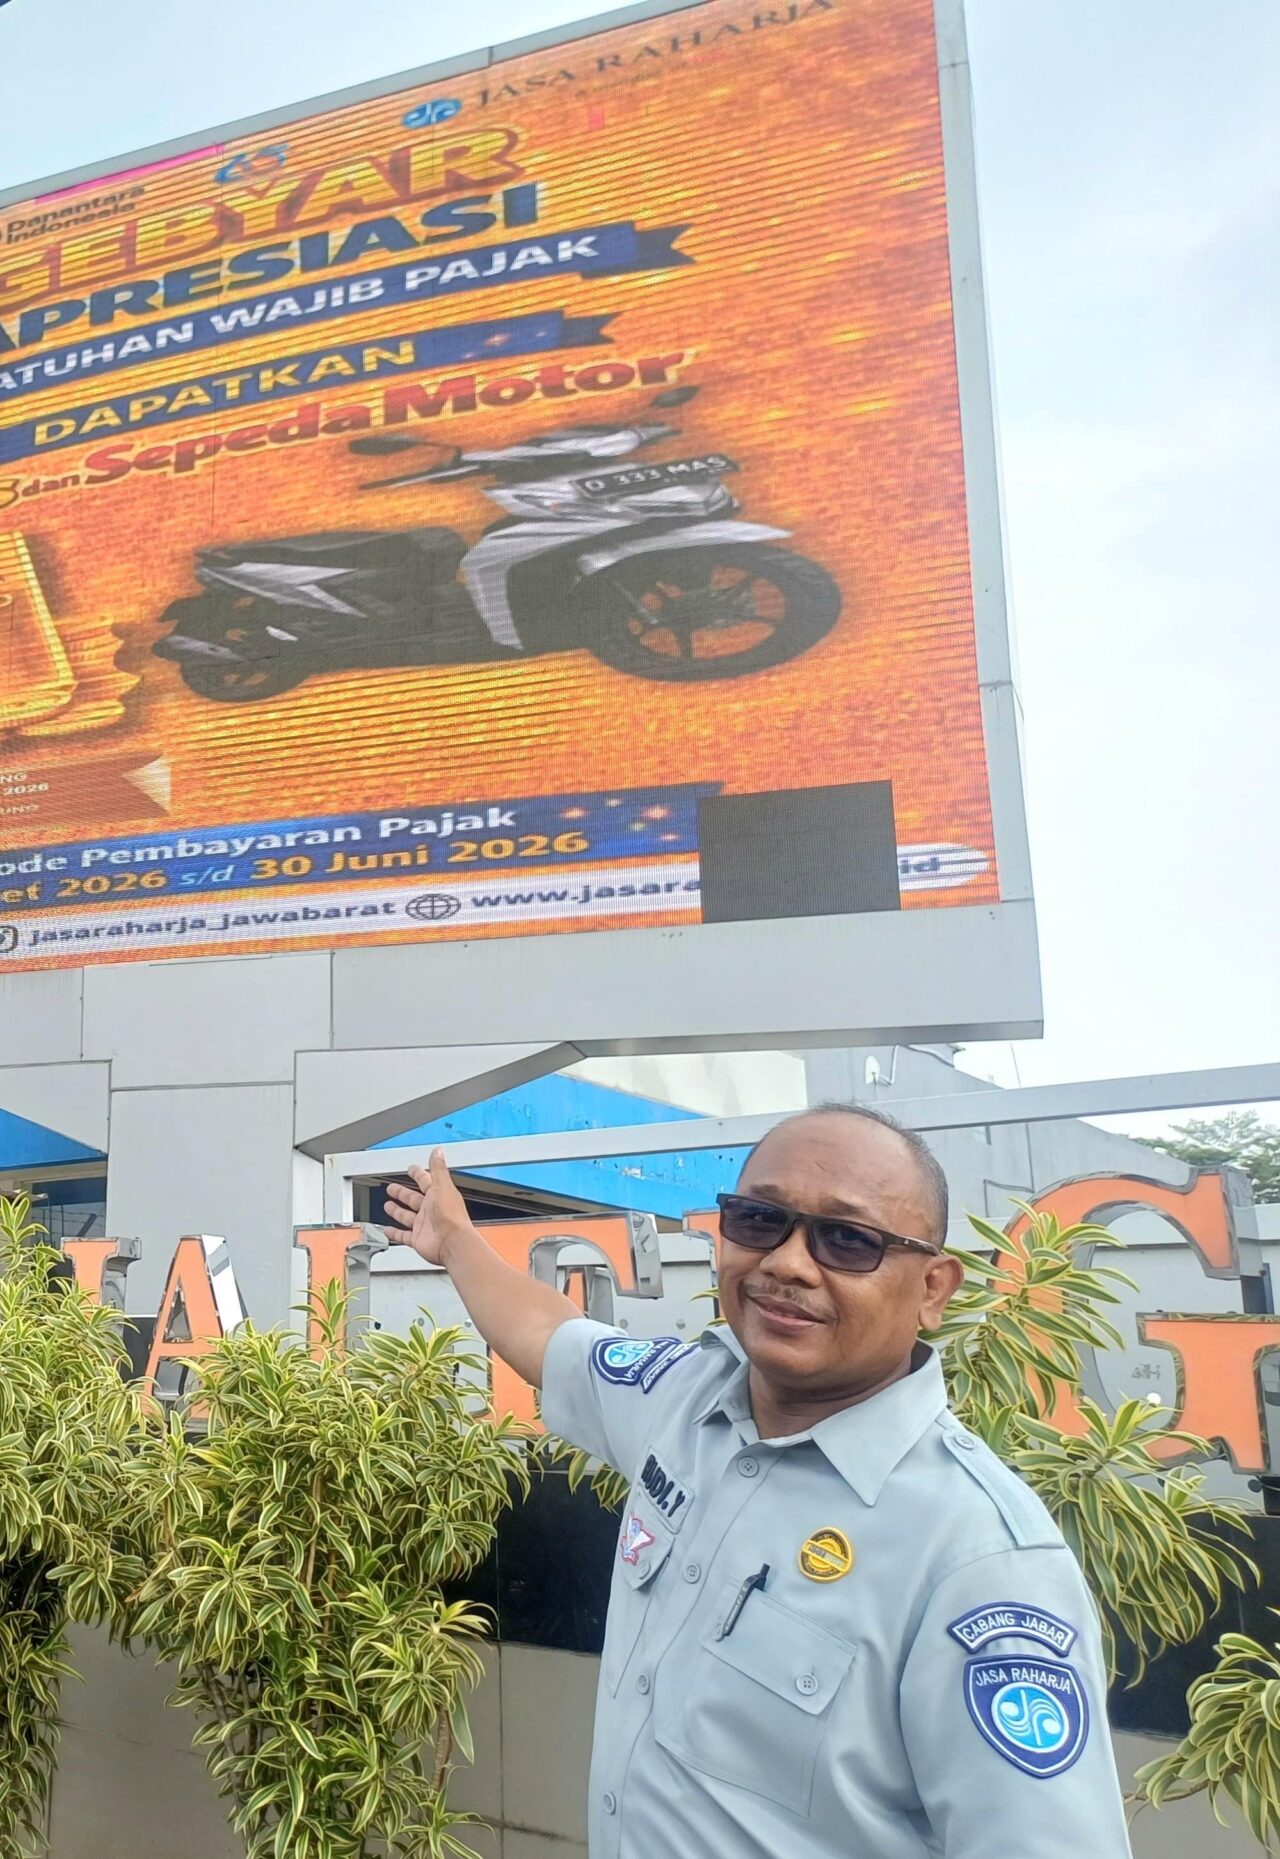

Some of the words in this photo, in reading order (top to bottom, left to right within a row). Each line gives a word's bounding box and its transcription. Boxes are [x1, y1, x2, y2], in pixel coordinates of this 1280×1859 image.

[477, 68, 576, 107] JASA
[594, 0, 833, 73] RAHARJA
[6, 202, 136, 245] Indonesia
[8, 185, 145, 233] Danantara
[210, 279, 384, 333] WAJIB
[405, 234, 600, 291] PAJAK
[33, 341, 415, 447] DAPATKAN
[22, 473, 81, 499] dan
[84, 403, 371, 485] Sepeda
[382, 350, 698, 424] Motor
[2, 782, 50, 796] 2026
[81, 827, 362, 867] Pembayaran
[379, 807, 519, 838] Pajak
[58, 869, 167, 898] 2026
[180, 866, 235, 886] s/d
[250, 855, 312, 880] 30
[325, 844, 429, 873] Juni
[447, 832, 590, 864] 2026
[29, 901, 395, 946] jasaraharja_jawabarat
[962, 1612, 1016, 1641] CABANG
[1020, 1615, 1066, 1645] JABAR
[975, 1667, 1009, 1687] JASA
[1011, 1667, 1072, 1695] RAHARJA
